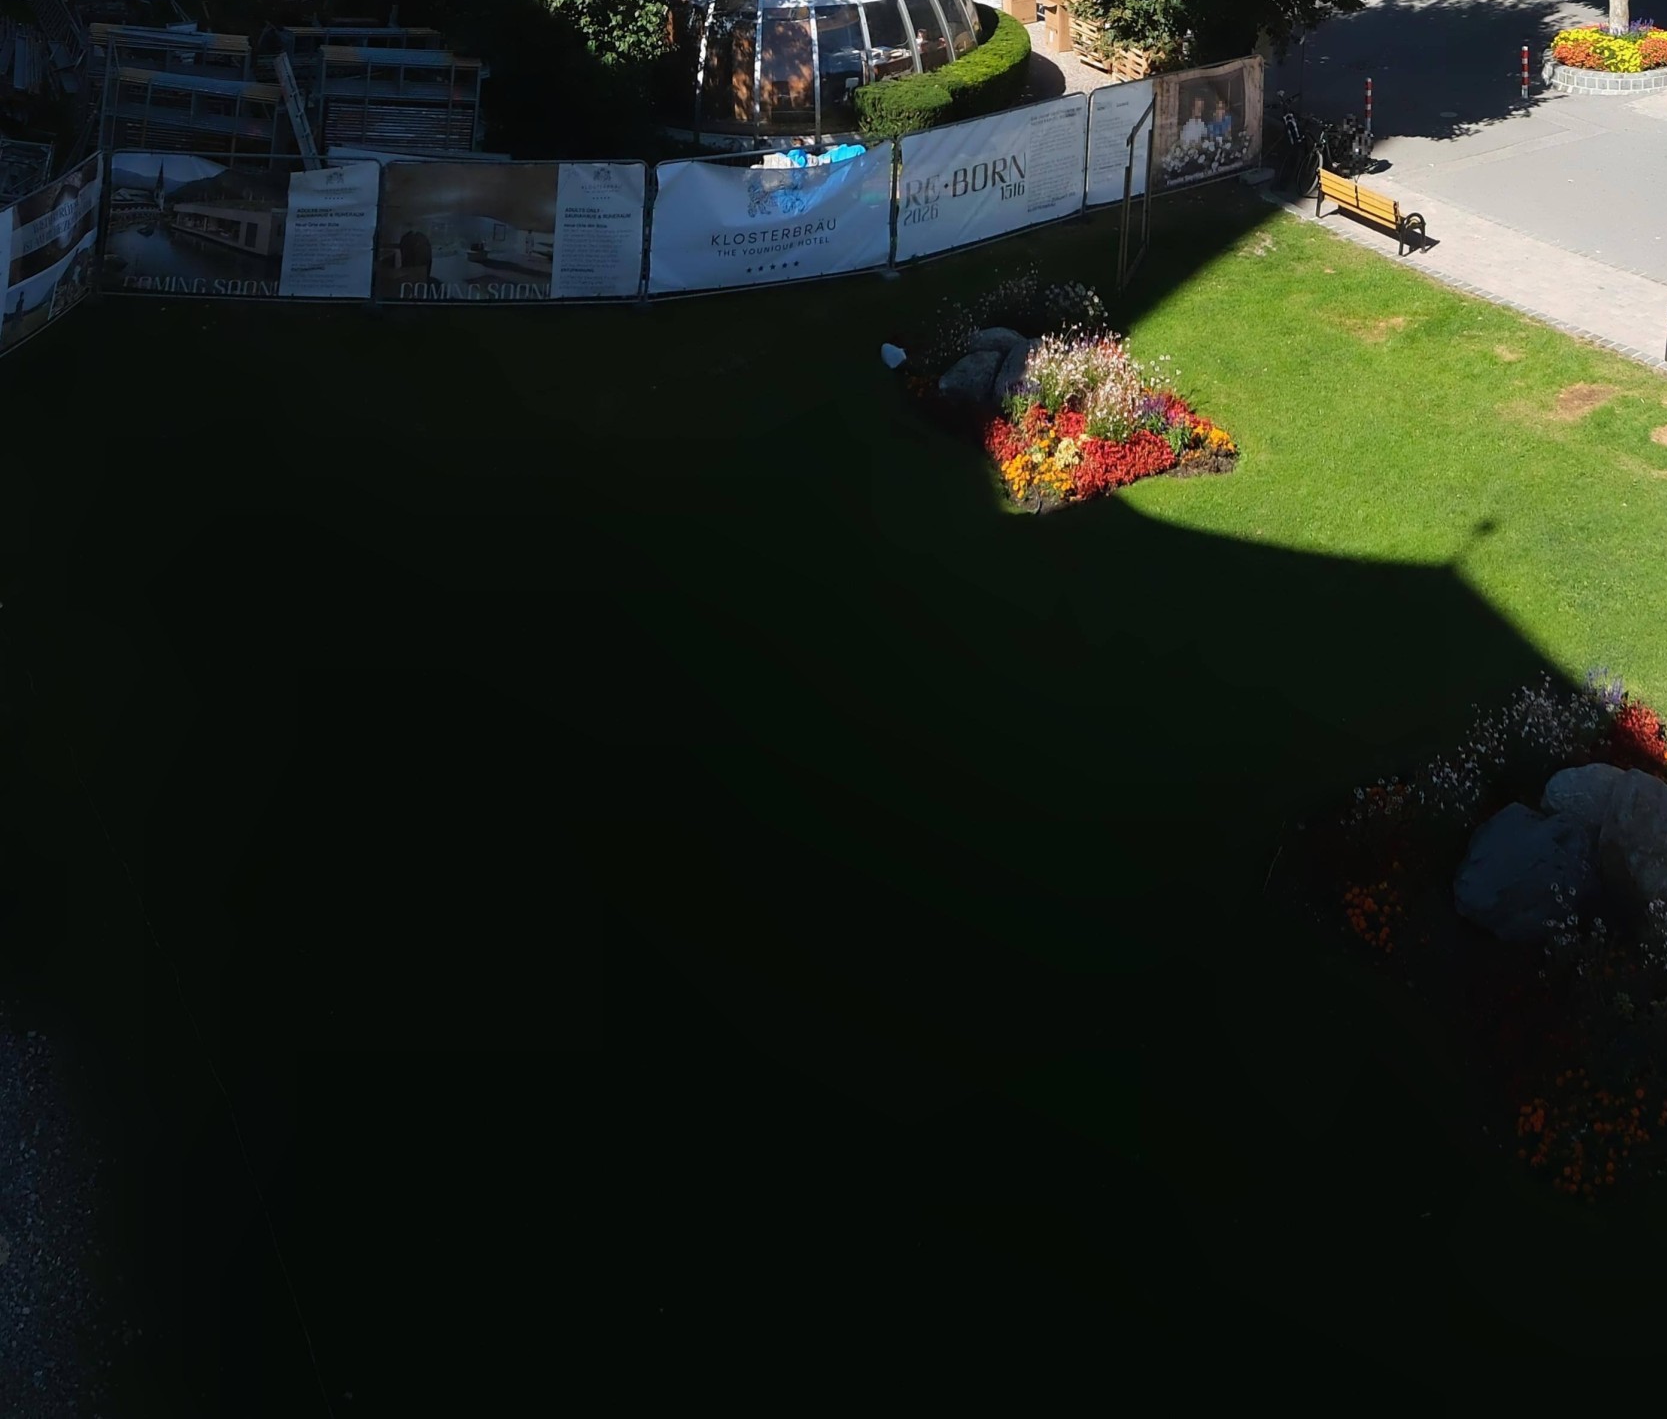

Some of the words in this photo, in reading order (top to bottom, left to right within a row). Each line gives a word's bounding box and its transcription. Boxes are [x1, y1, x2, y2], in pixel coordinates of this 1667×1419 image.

[1000, 182, 1025, 201] 1516
[904, 203, 939, 226] 2026
[711, 218, 837, 246] KLOSTERBRÄU
[717, 248, 737, 257] THE
[742, 244, 794, 256] YOUNIQUE
[798, 236, 830, 247] HOTEL
